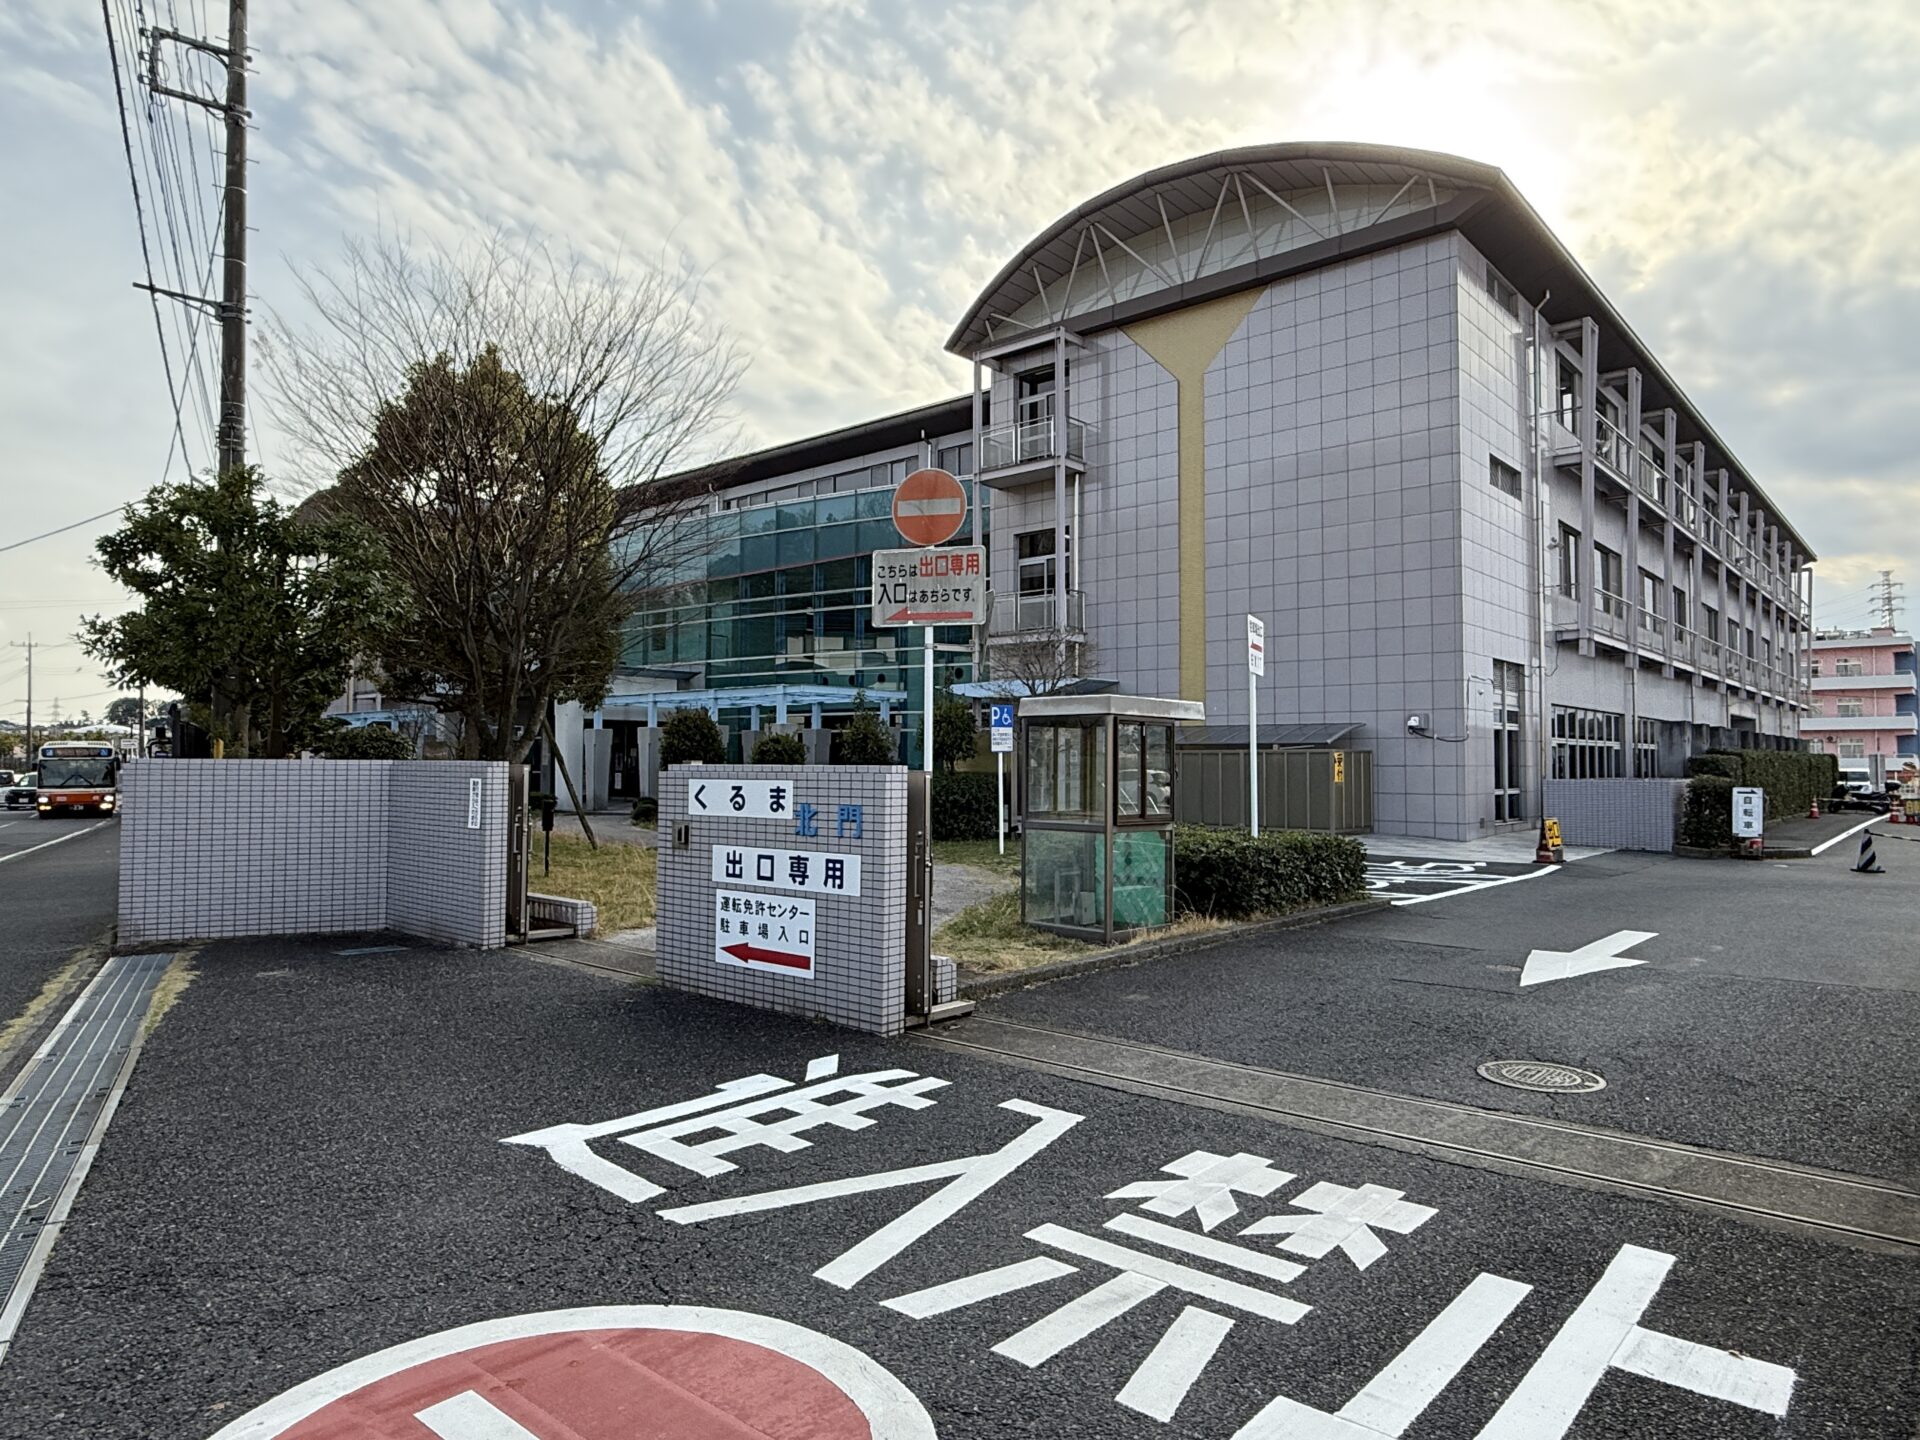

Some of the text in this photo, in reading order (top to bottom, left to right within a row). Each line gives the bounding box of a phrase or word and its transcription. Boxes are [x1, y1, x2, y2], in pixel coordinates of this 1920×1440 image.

[878, 553, 980, 579] こちらは出口専用
[991, 706, 1001, 726] P
[694, 784, 786, 812] くるま
[795, 802, 863, 839] 北門
[1743, 796, 1753, 829] 自転車
[725, 850, 844, 890] 出口専用
[720, 896, 810, 921] 運転免許センター
[720, 917, 809, 945] 駐車場入口
